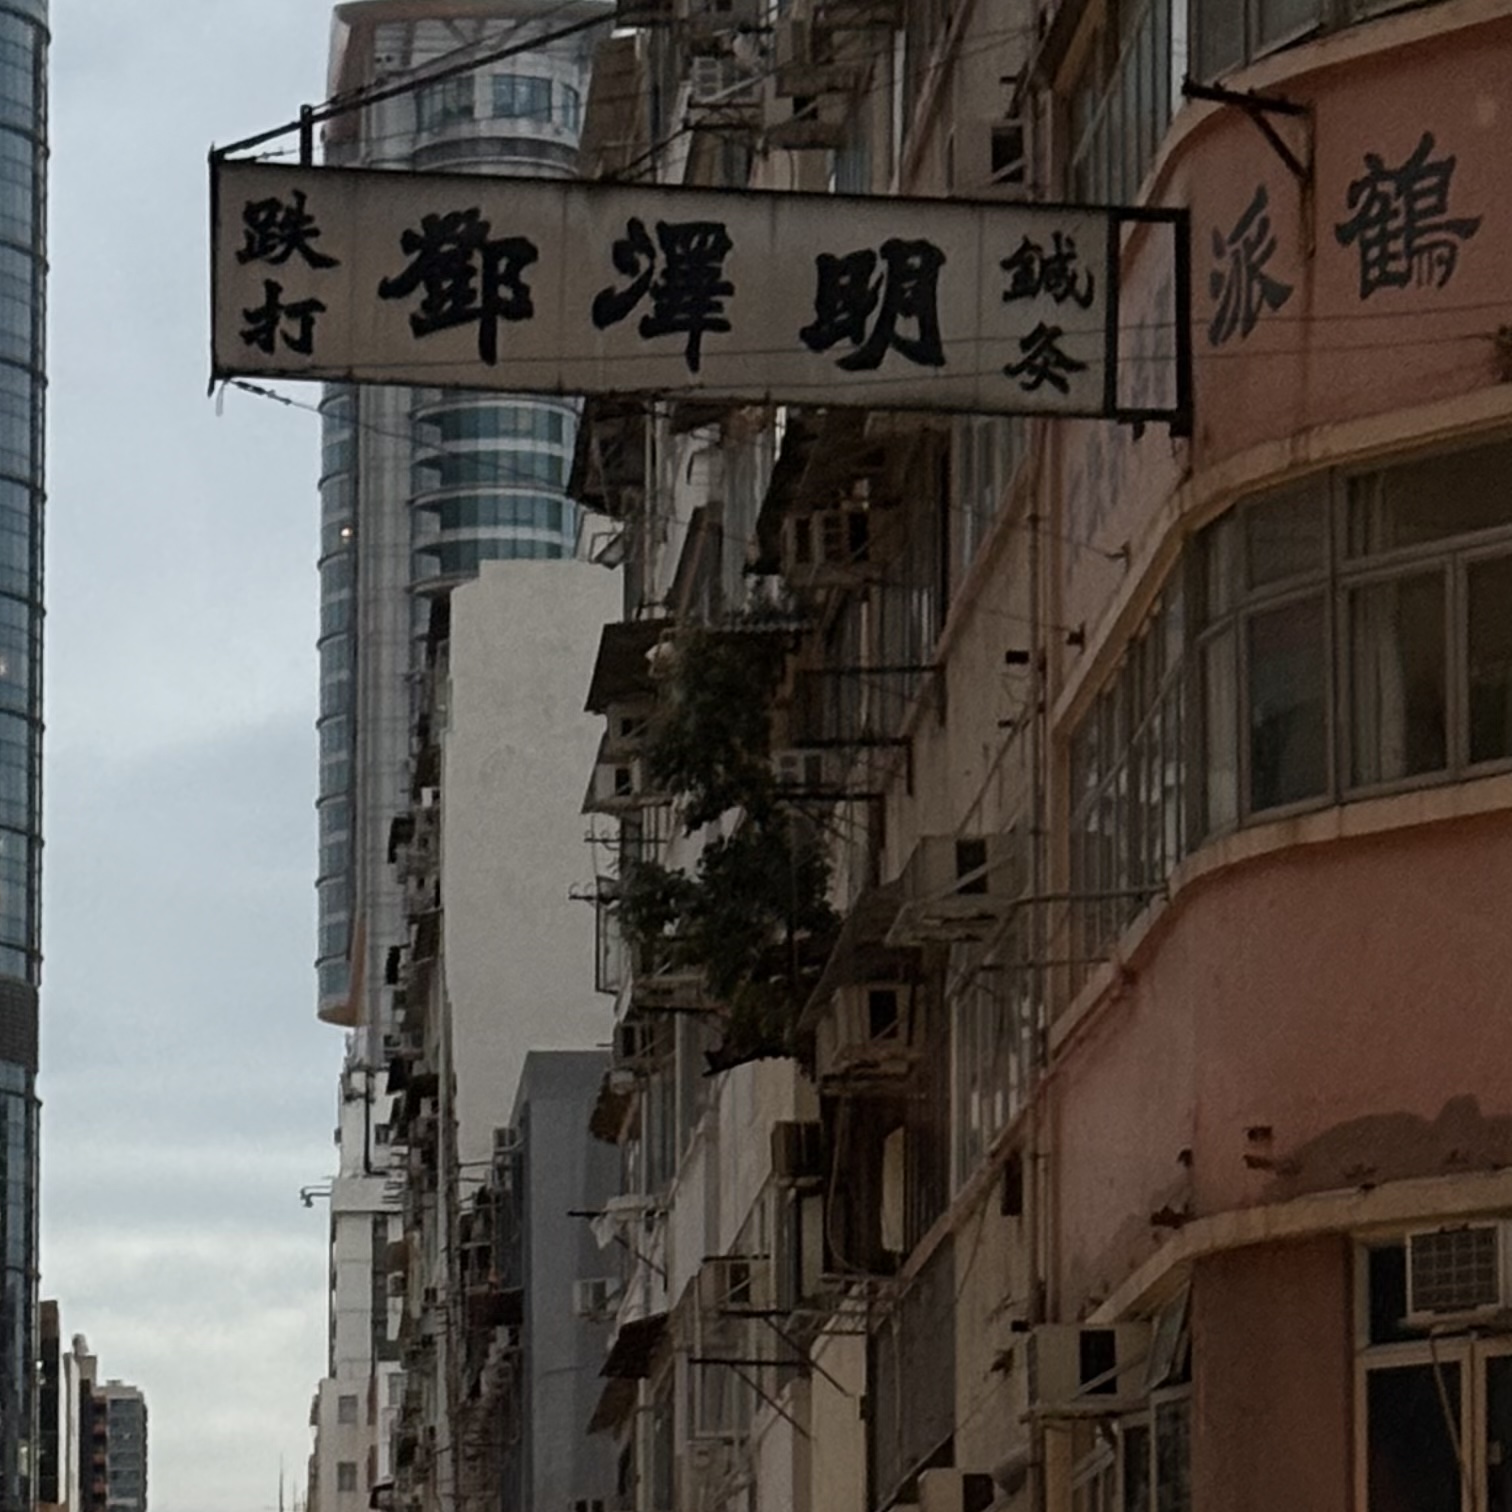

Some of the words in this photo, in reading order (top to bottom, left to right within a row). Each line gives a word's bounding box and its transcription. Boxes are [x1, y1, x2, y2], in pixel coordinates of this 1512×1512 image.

[236, 190, 341, 356] 跌打
[378, 207, 948, 372] 鄧澤明
